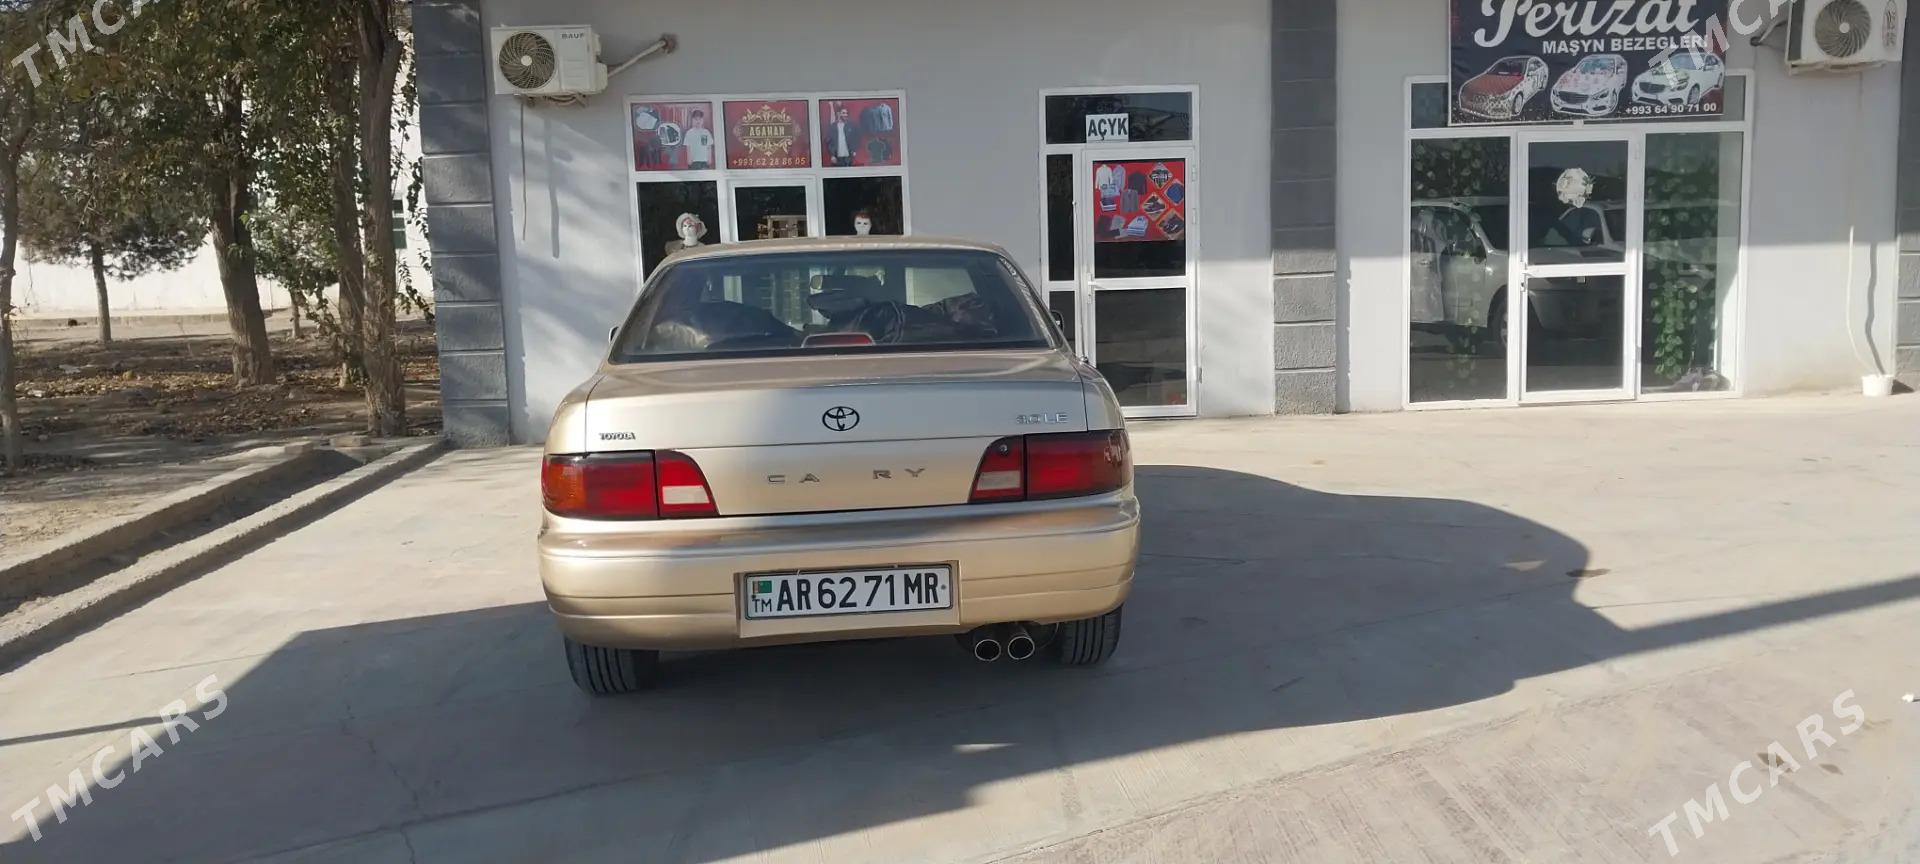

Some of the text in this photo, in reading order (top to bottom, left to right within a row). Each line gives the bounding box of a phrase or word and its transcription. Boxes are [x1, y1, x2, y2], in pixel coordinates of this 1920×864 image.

[1542, 38, 1605, 56] MAŞYN
[1625, 102, 1717, 115] +993 64 90 71 00
[1088, 118, 1127, 140] AÇYK
